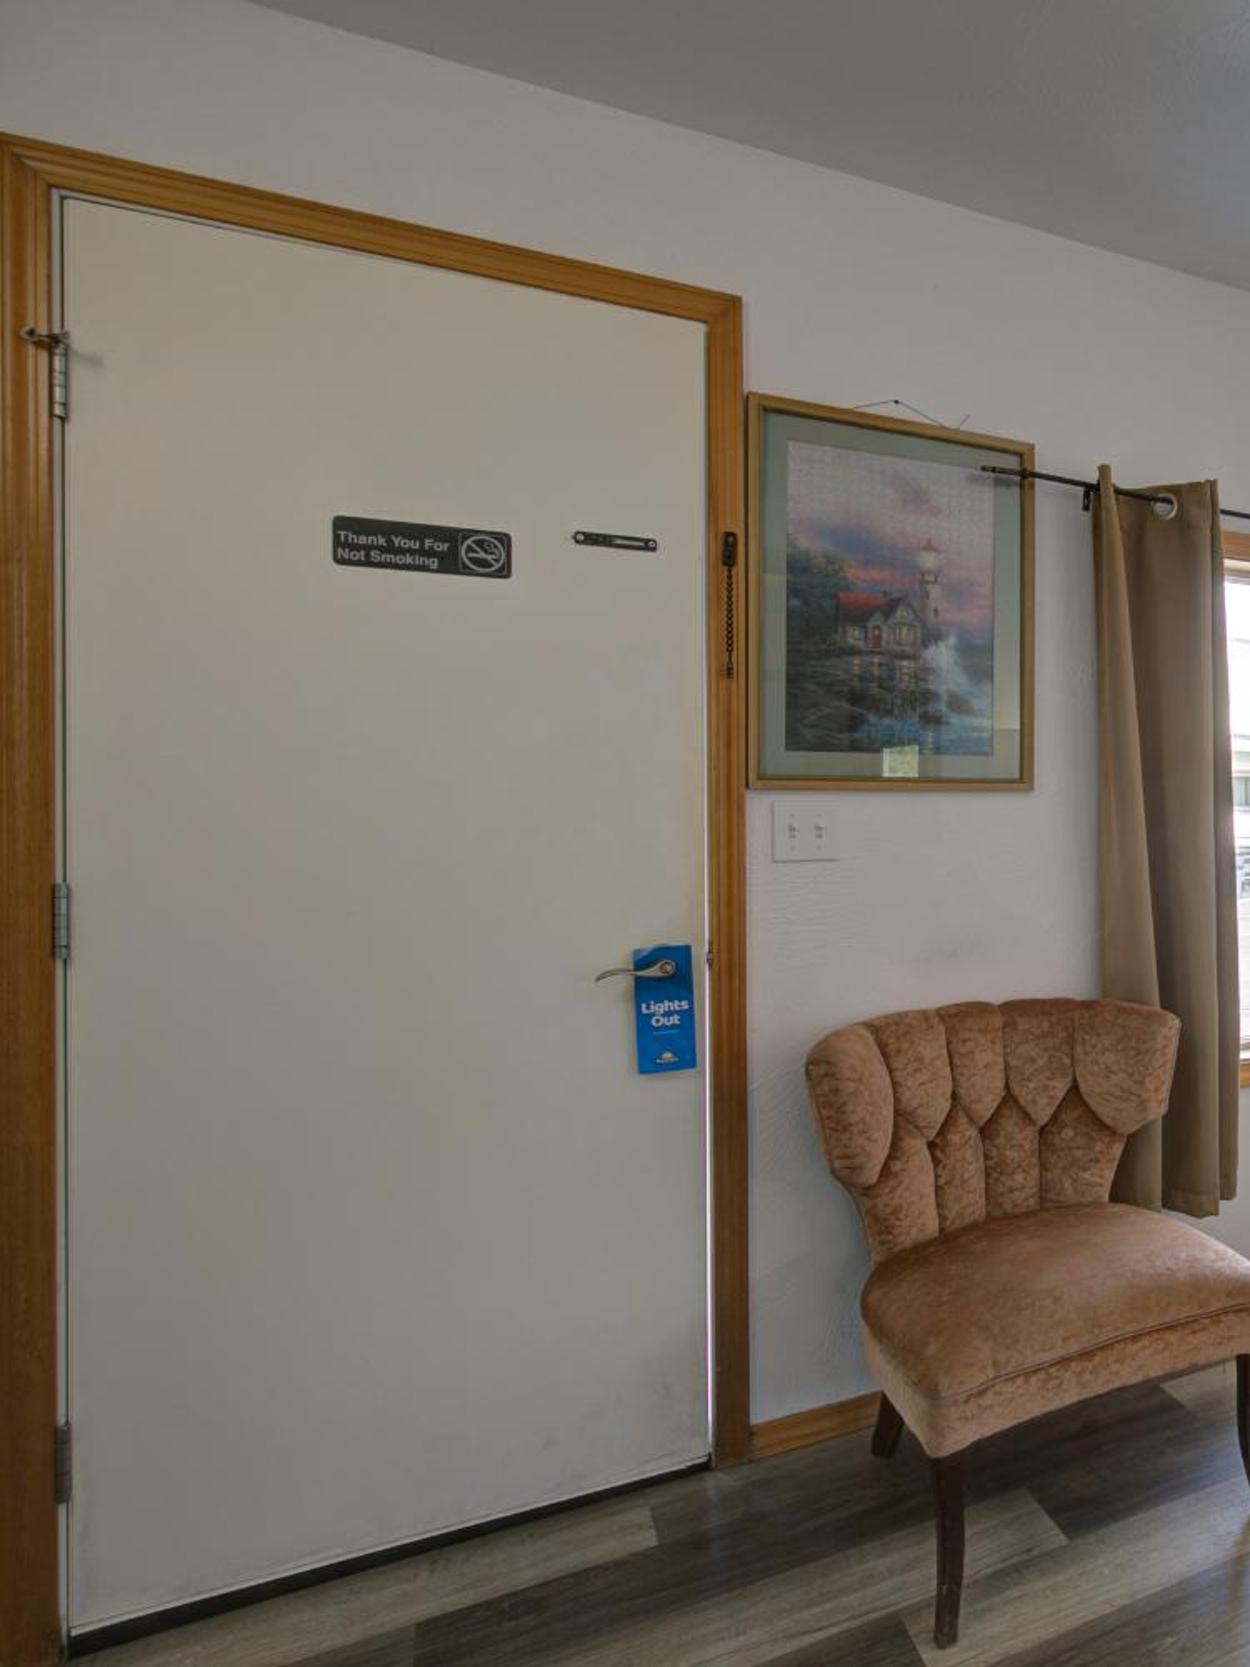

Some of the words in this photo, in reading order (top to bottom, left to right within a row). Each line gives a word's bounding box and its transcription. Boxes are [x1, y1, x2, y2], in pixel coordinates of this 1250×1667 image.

[337, 531, 387, 546] Thank
[391, 536, 420, 549] You
[425, 538, 449, 551] For
[337, 548, 366, 561] Not
[371, 550, 438, 569] Smoking
[641, 1000, 689, 1014] Lights
[651, 1014, 681, 1027] Out
